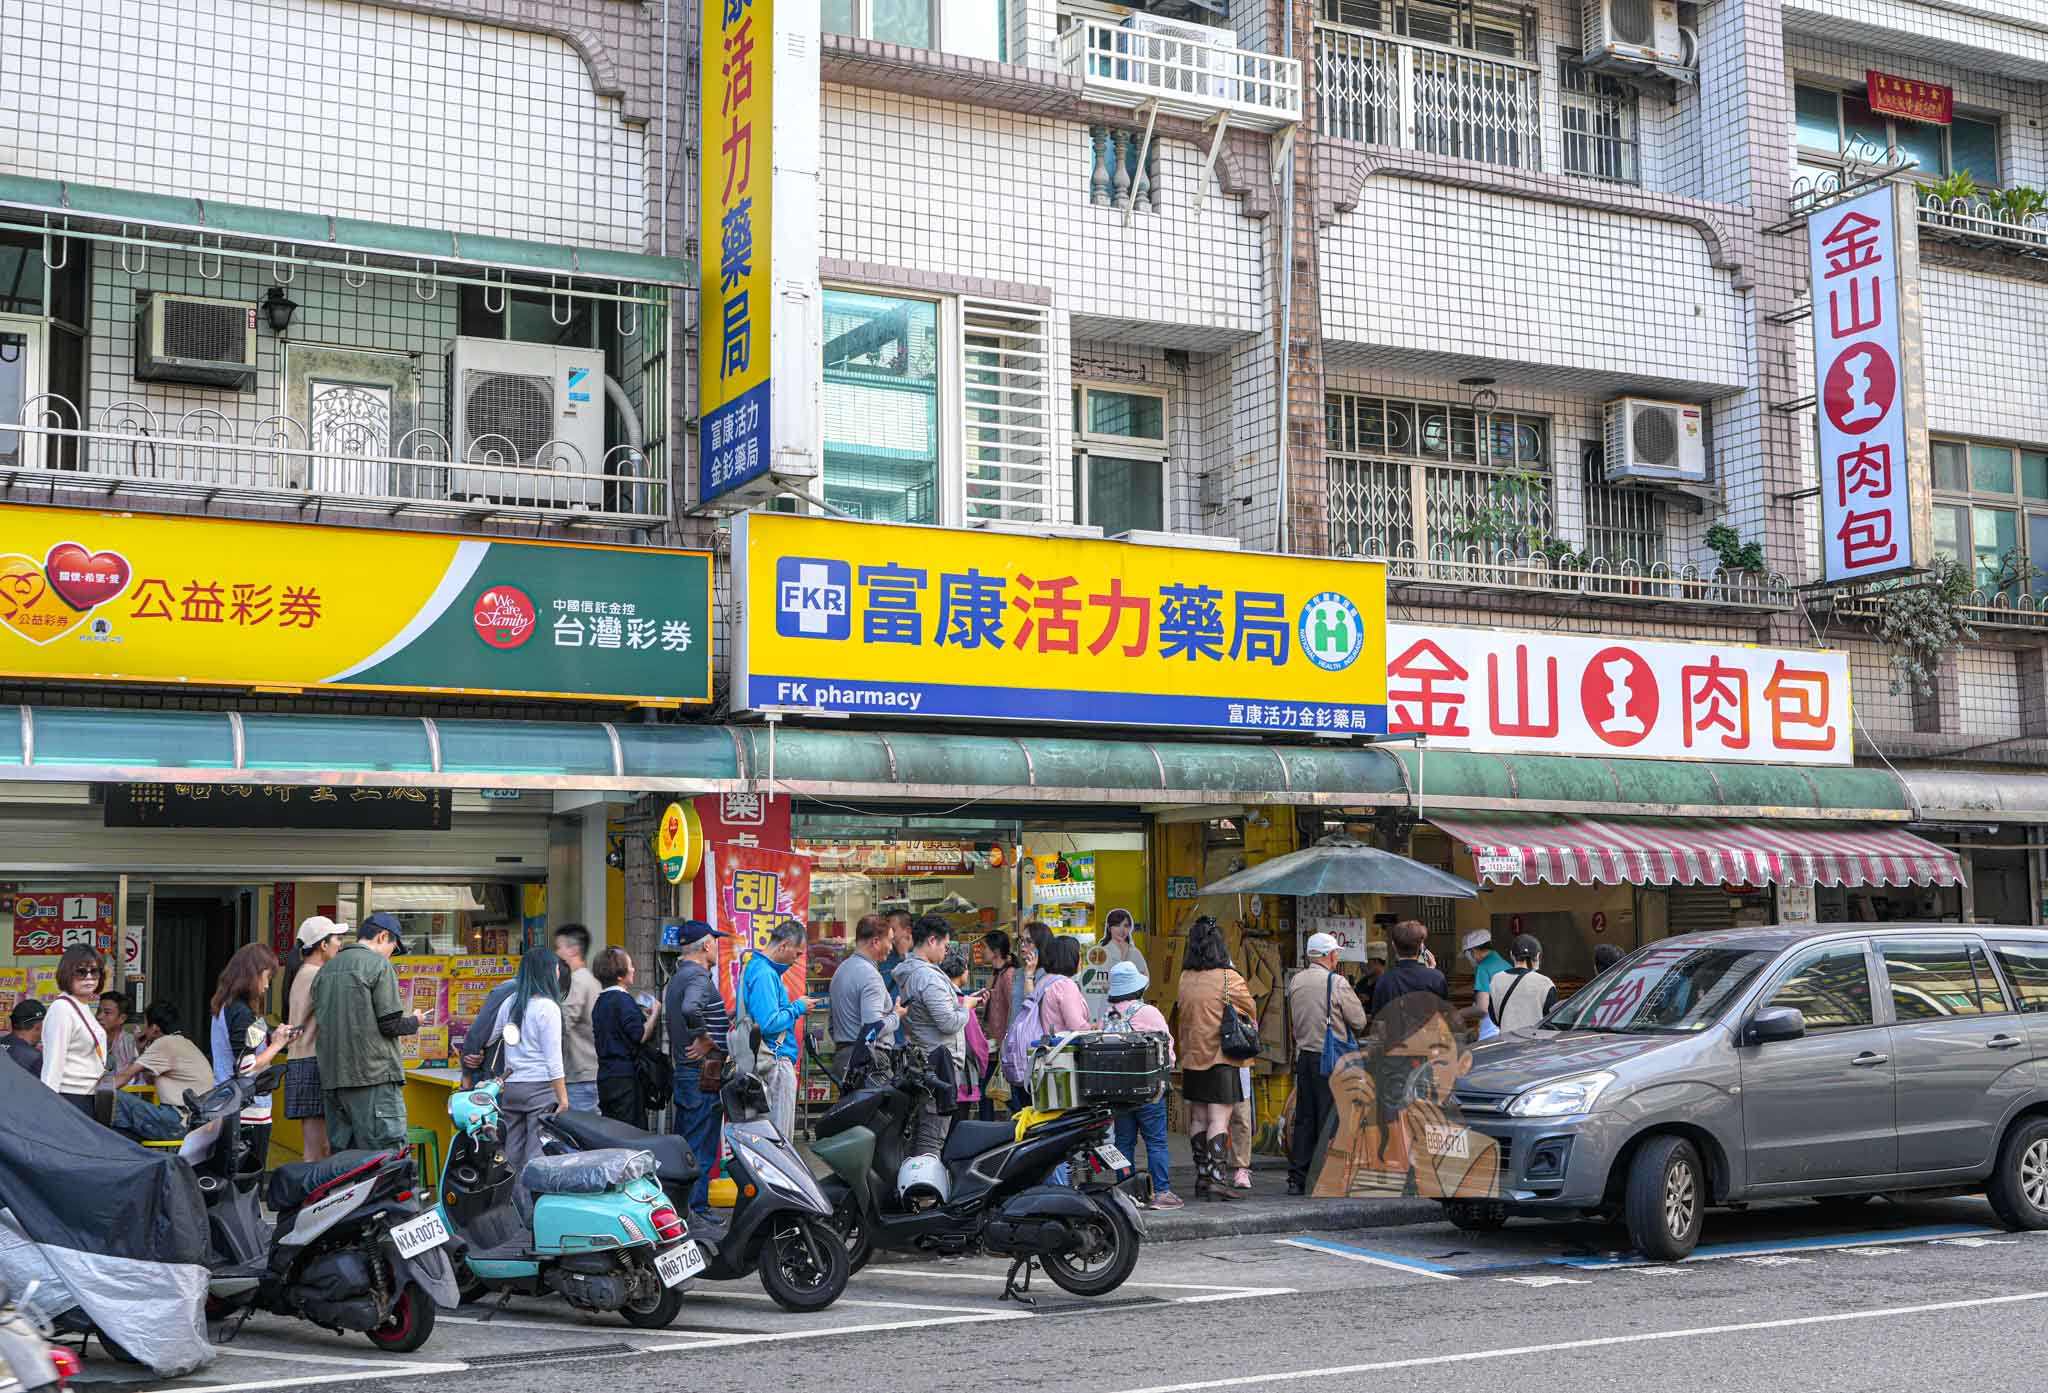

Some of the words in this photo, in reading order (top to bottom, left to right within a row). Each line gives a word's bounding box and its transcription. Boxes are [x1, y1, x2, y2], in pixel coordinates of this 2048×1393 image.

[711, 400, 759, 451] 富康活力
[130, 578, 322, 628] 公益彩券
[495, 592, 515, 607] We
[553, 599, 636, 616] 中國信託金控
[857, 561, 1291, 666] 富康活力藥局
[552, 614, 693, 652] 台灣彩券
[777, 682, 808, 702] FK
[815, 685, 922, 711] pharmacy
[395, 1219, 444, 1252] NXA-0073
[659, 1248, 701, 1281] MNB-7260
